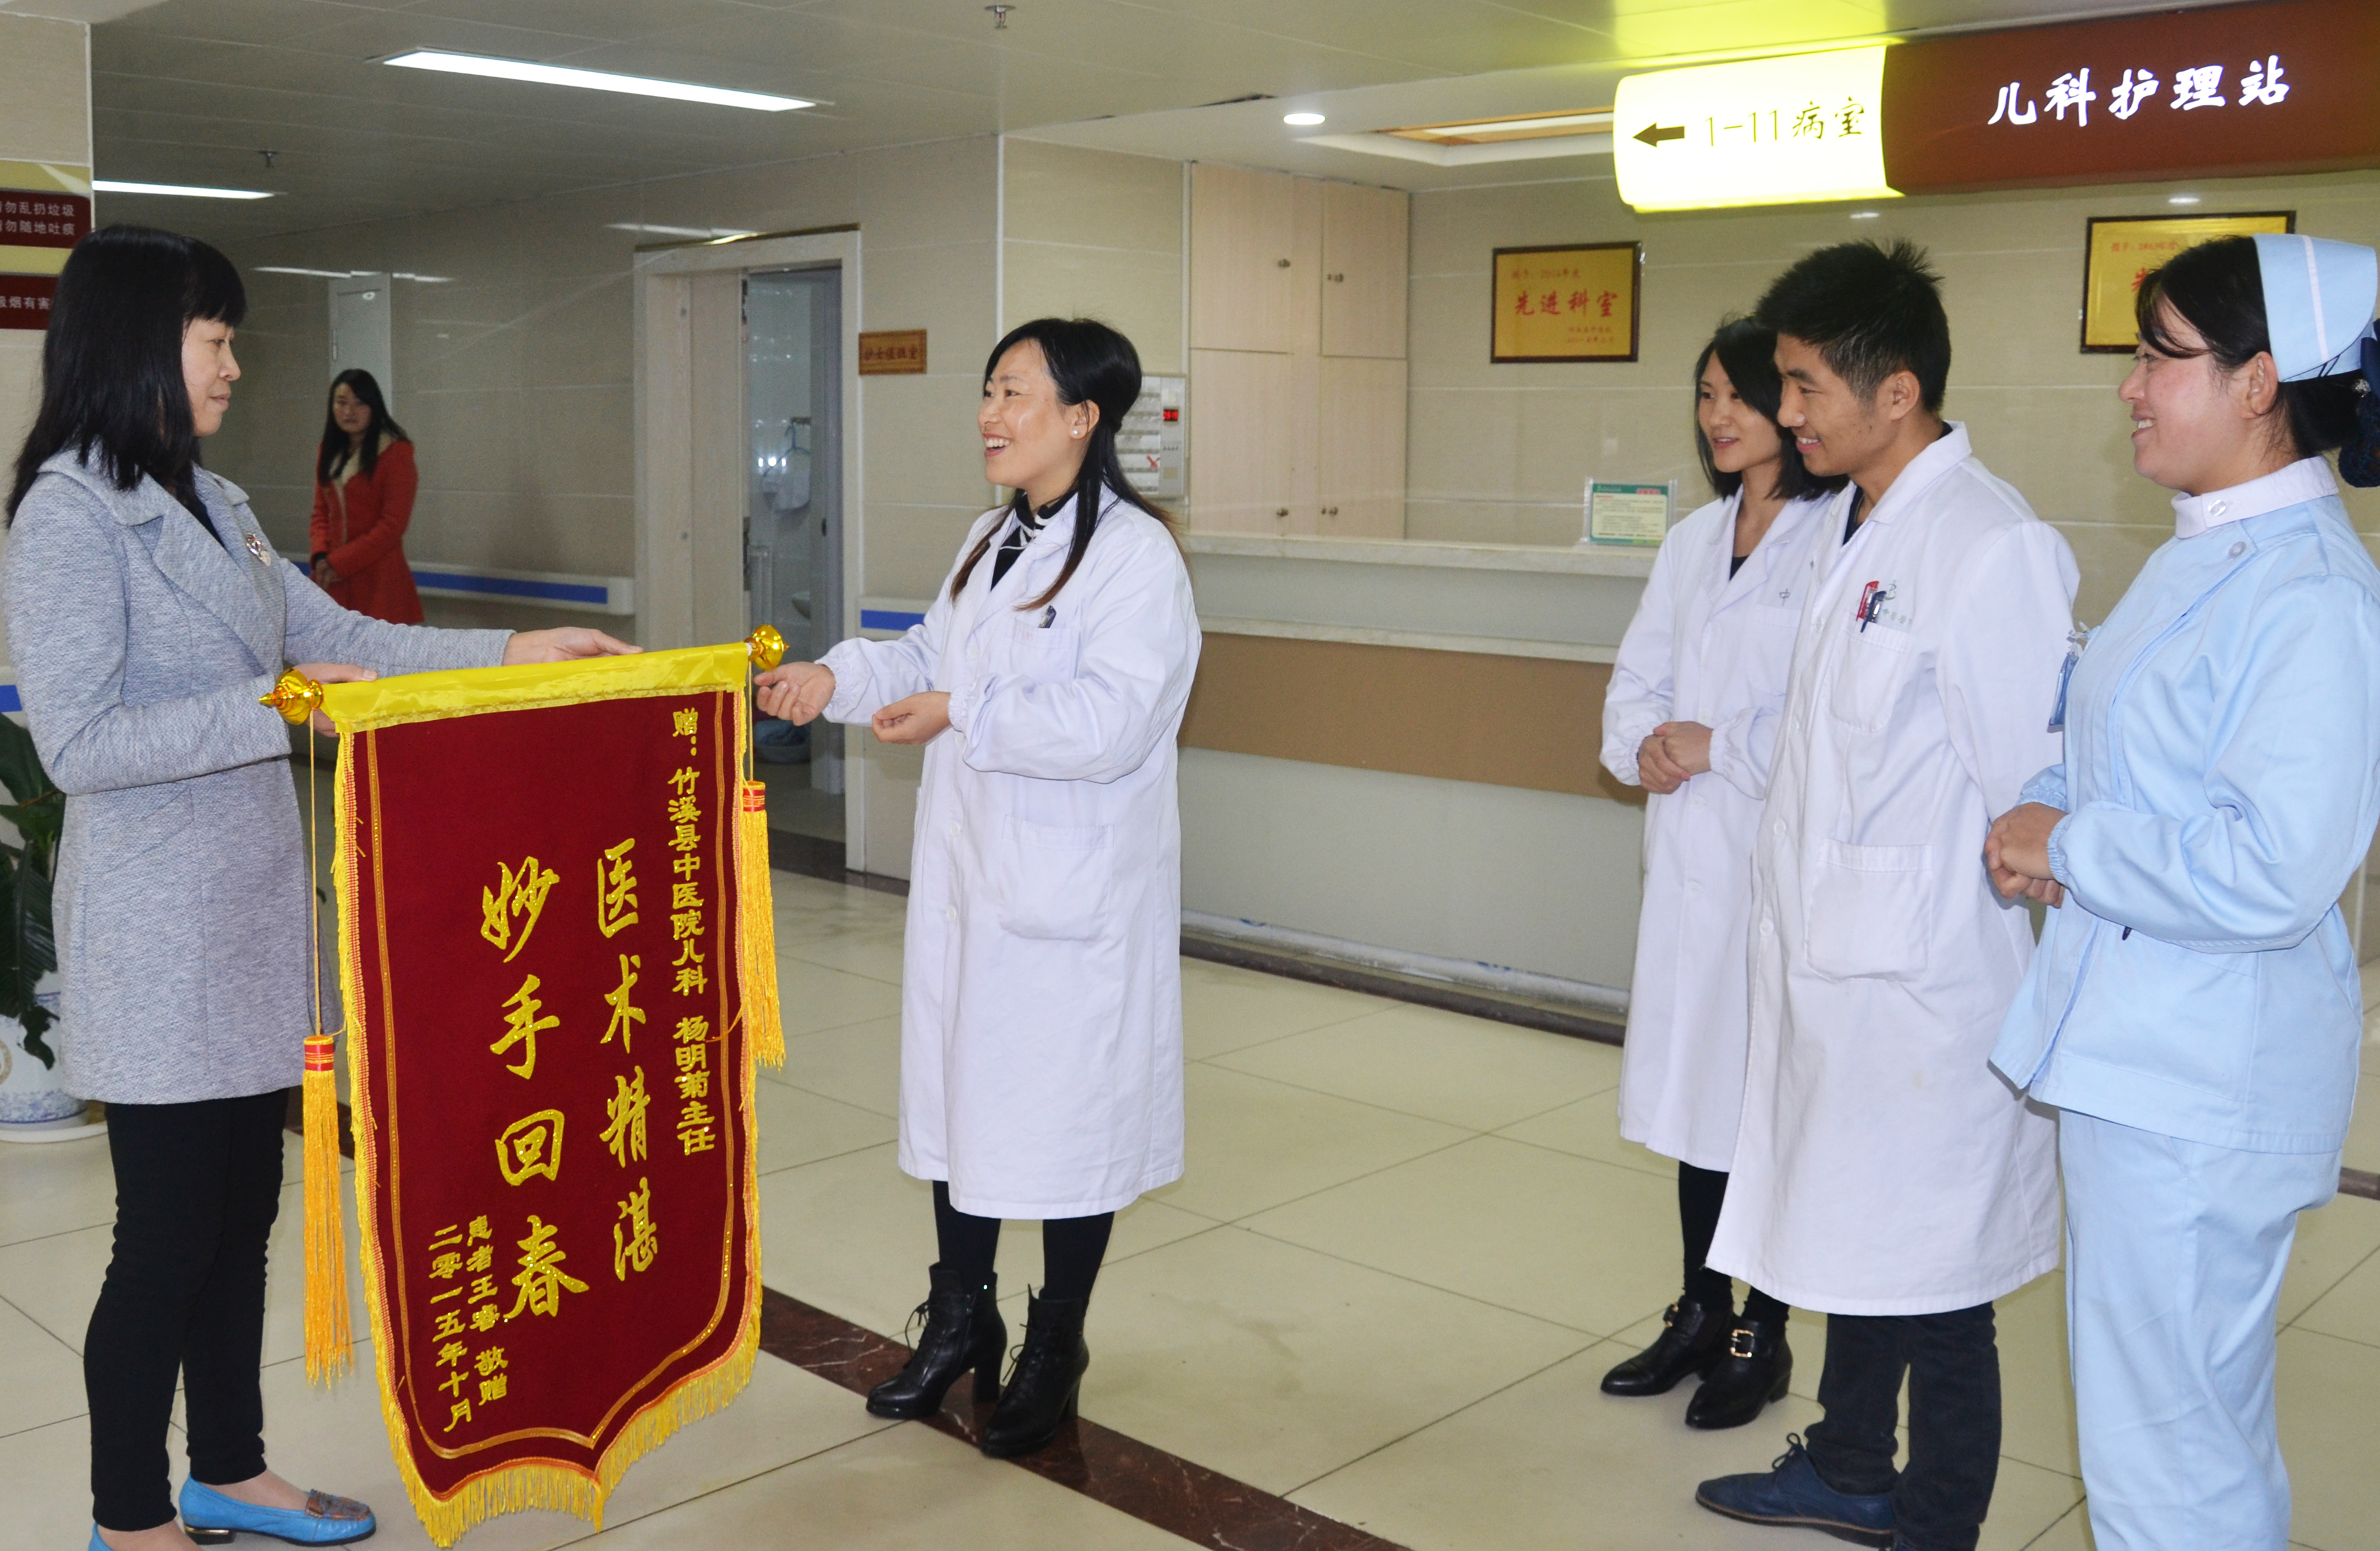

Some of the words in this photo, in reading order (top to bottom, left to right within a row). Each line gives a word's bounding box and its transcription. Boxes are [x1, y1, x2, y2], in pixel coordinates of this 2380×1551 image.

[1705, 96, 1865, 146] 1-11病室
[1987, 54, 2290, 127] 儿科护理站
[0, 200, 75, 217] 勿乱扔垃圾
[0, 219, 75, 236] 勿随地吐痰
[1515, 287, 1618, 318] 先进科室
[667, 766, 709, 996] 竹溪县中医院儿科
[480, 855, 590, 1319] 妙手回春
[596, 837, 658, 1282] 医术精湛
[673, 1015, 716, 1156] 杨明菊主任
[428, 1224, 472, 1432] 二零一五年十月
[474, 1346, 508, 1406] 敬赠
